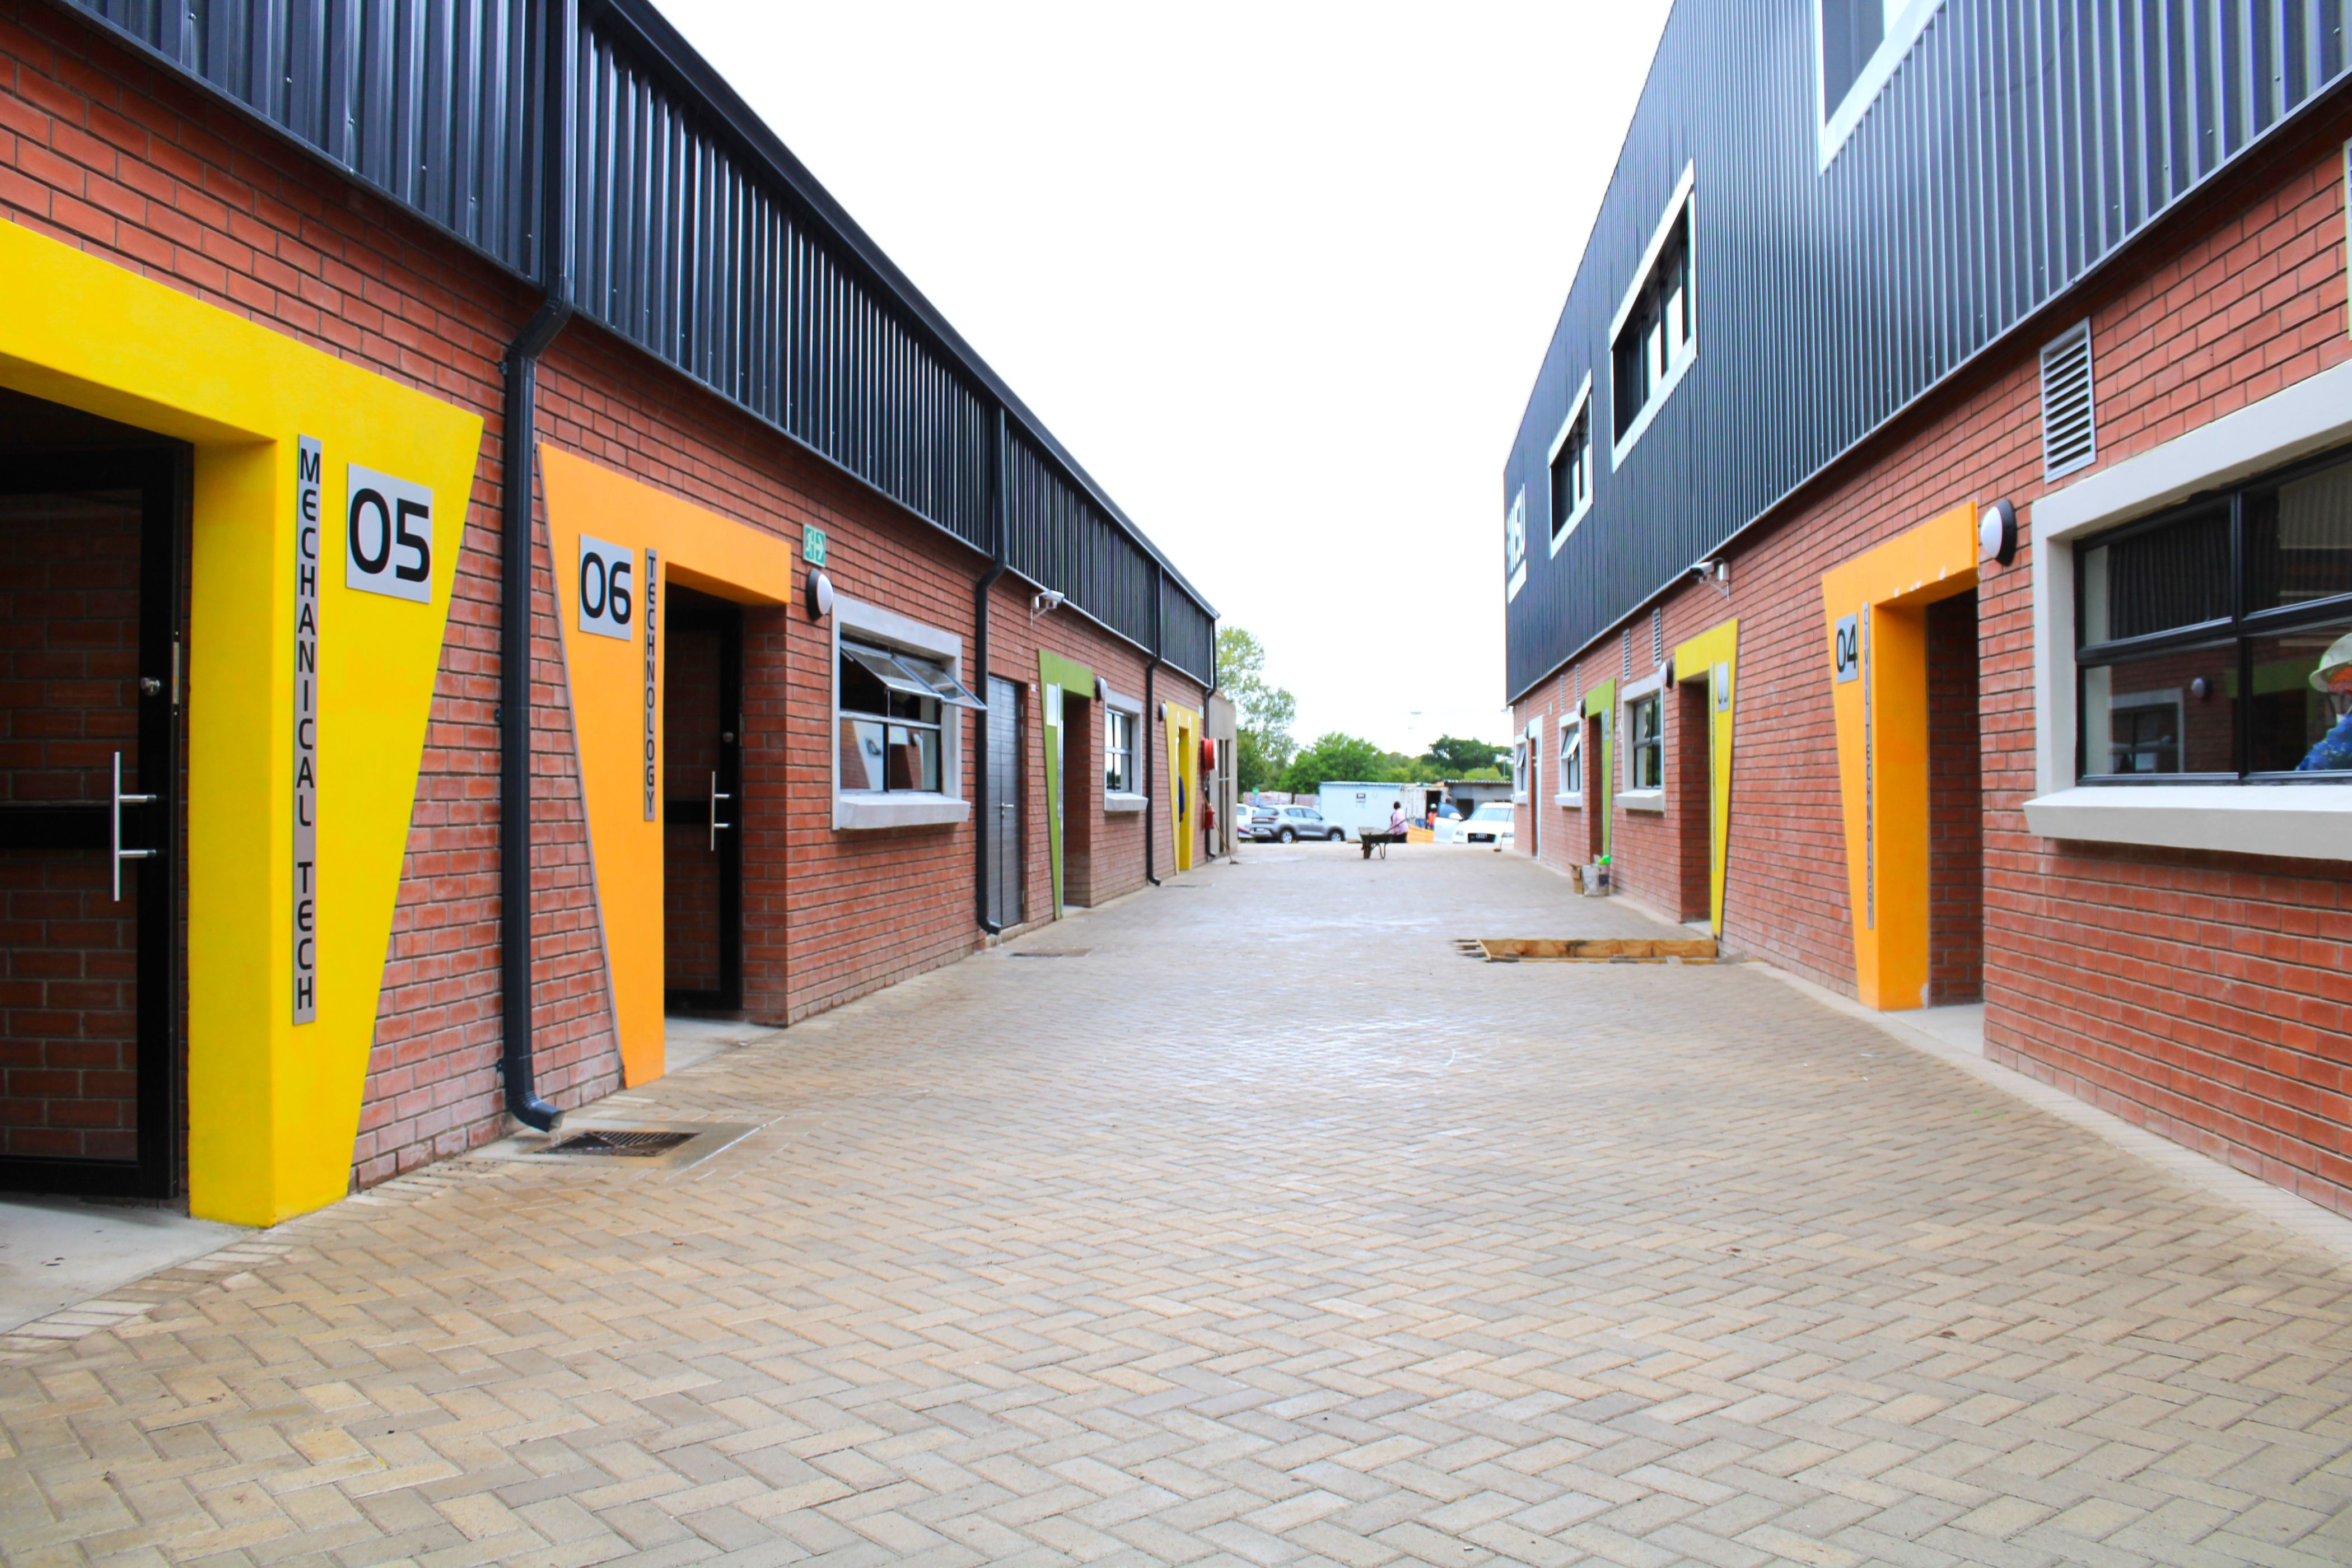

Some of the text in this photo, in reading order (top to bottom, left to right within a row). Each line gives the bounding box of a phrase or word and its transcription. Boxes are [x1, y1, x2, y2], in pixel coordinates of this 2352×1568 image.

[349, 487, 431, 583] 05
[581, 552, 632, 626] 06
[646, 556, 656, 813] TECHNOLOGY
[1836, 624, 1858, 673] 04
[297, 447, 320, 1010] MECHANICAL TECH
